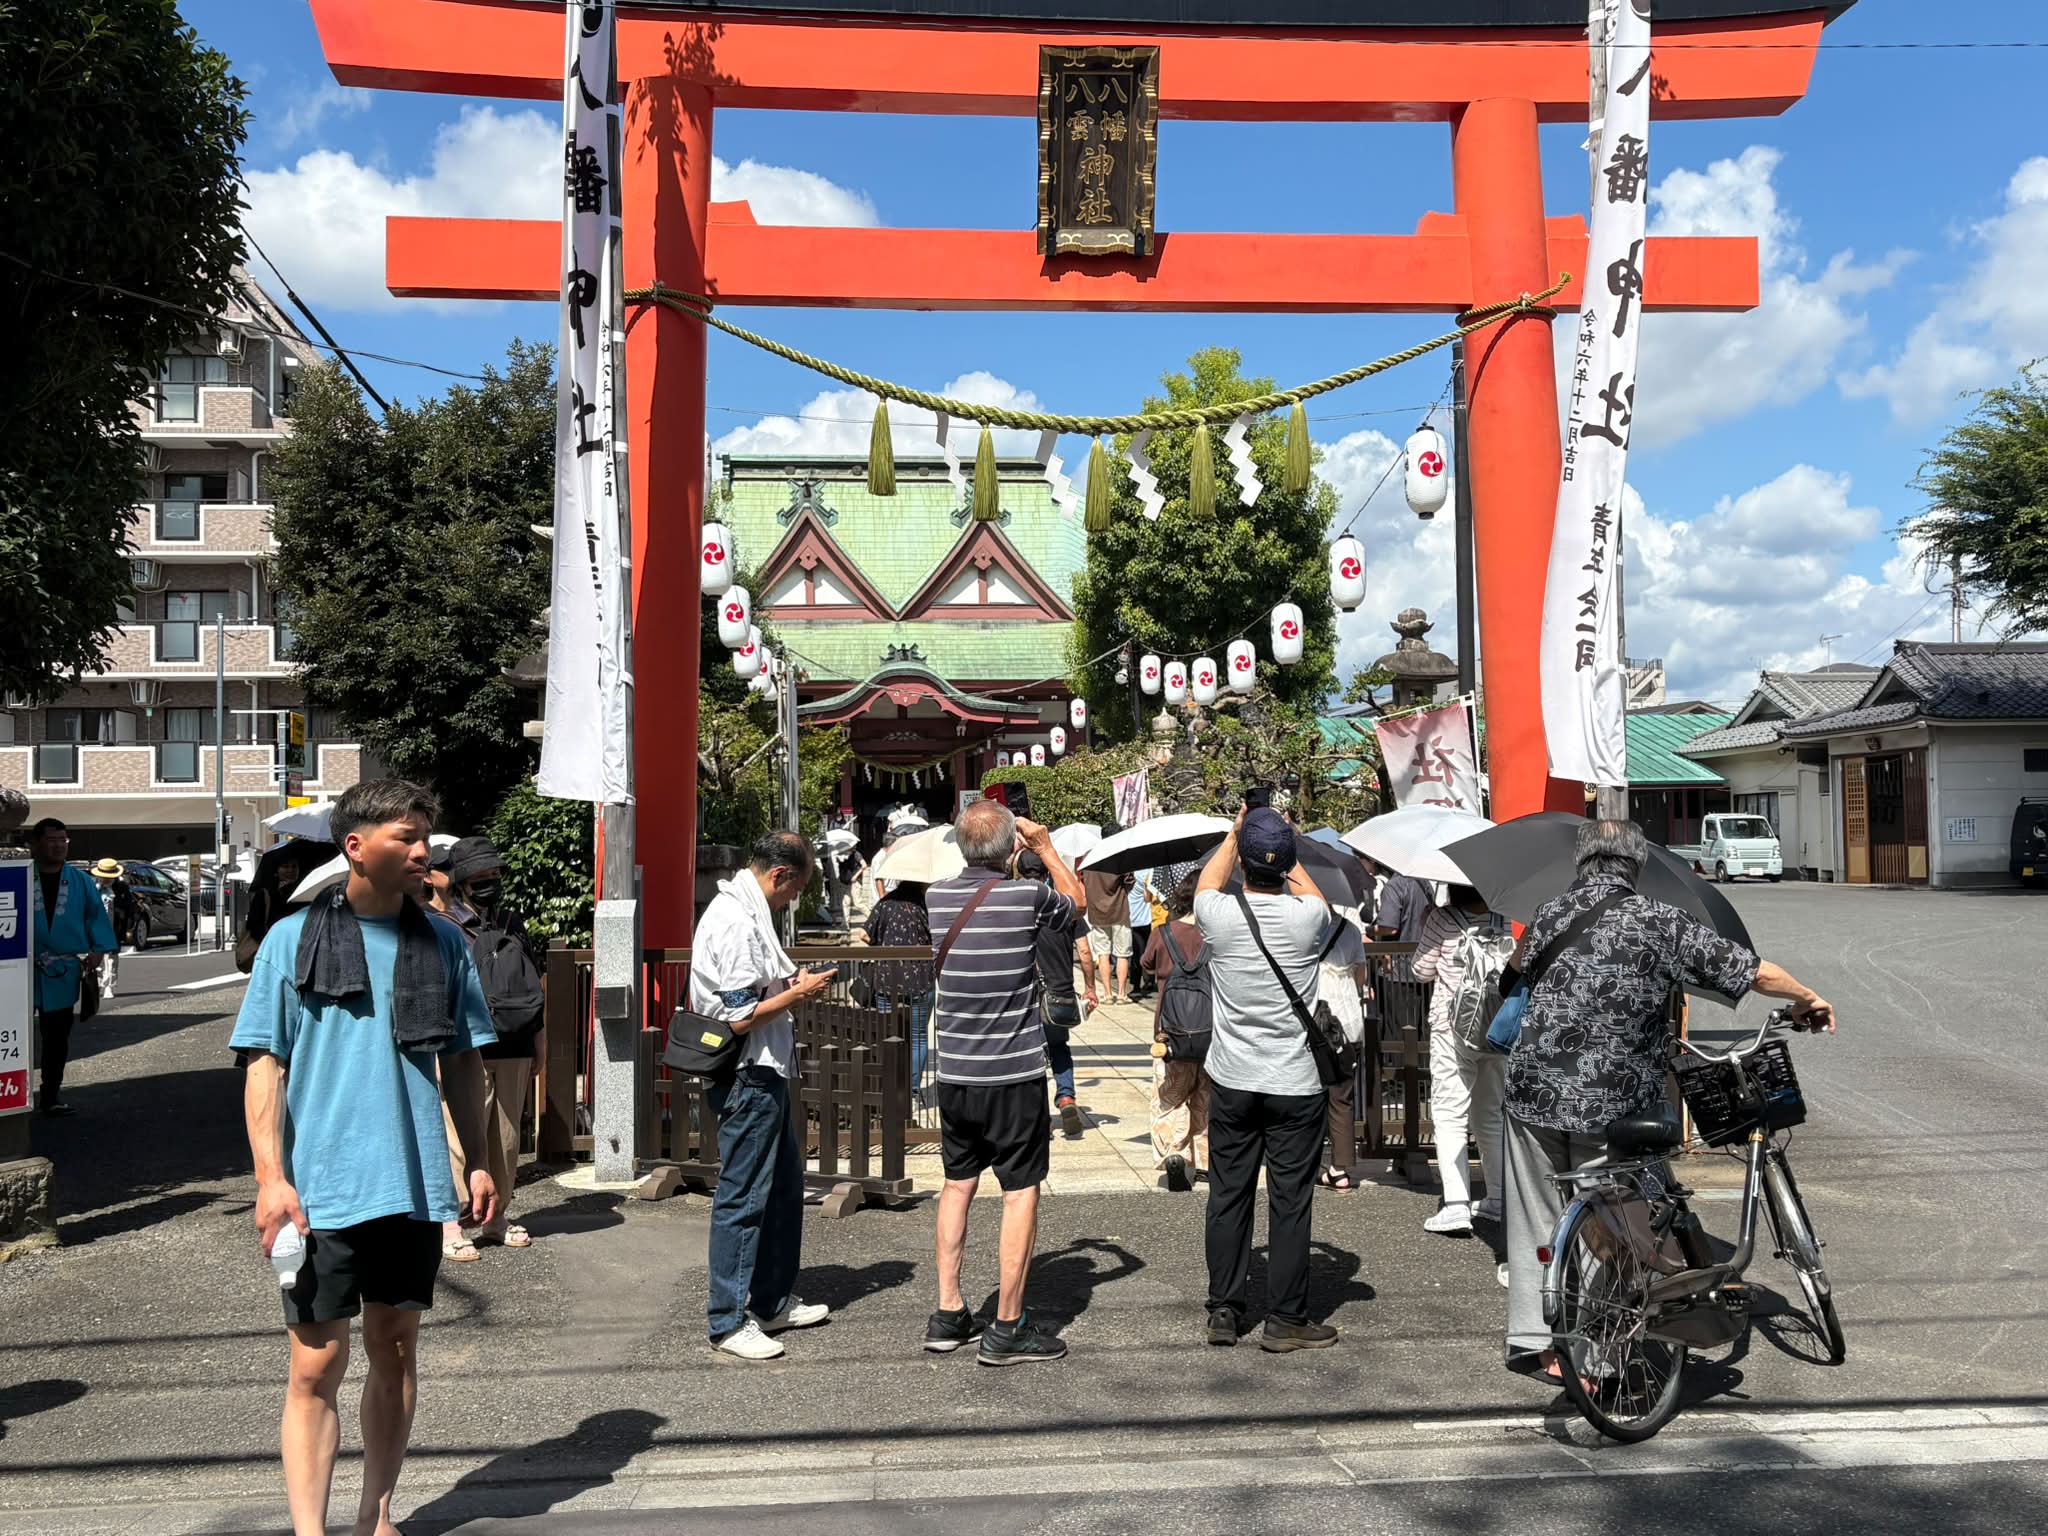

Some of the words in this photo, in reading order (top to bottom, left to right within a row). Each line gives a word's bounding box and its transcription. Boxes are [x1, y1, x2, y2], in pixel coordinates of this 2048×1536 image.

[1065, 77, 1095, 141] 八雲
[1097, 77, 1128, 141] 八幡
[1076, 144, 1115, 225] 神社
[0, 1046, 20, 1061] 74
